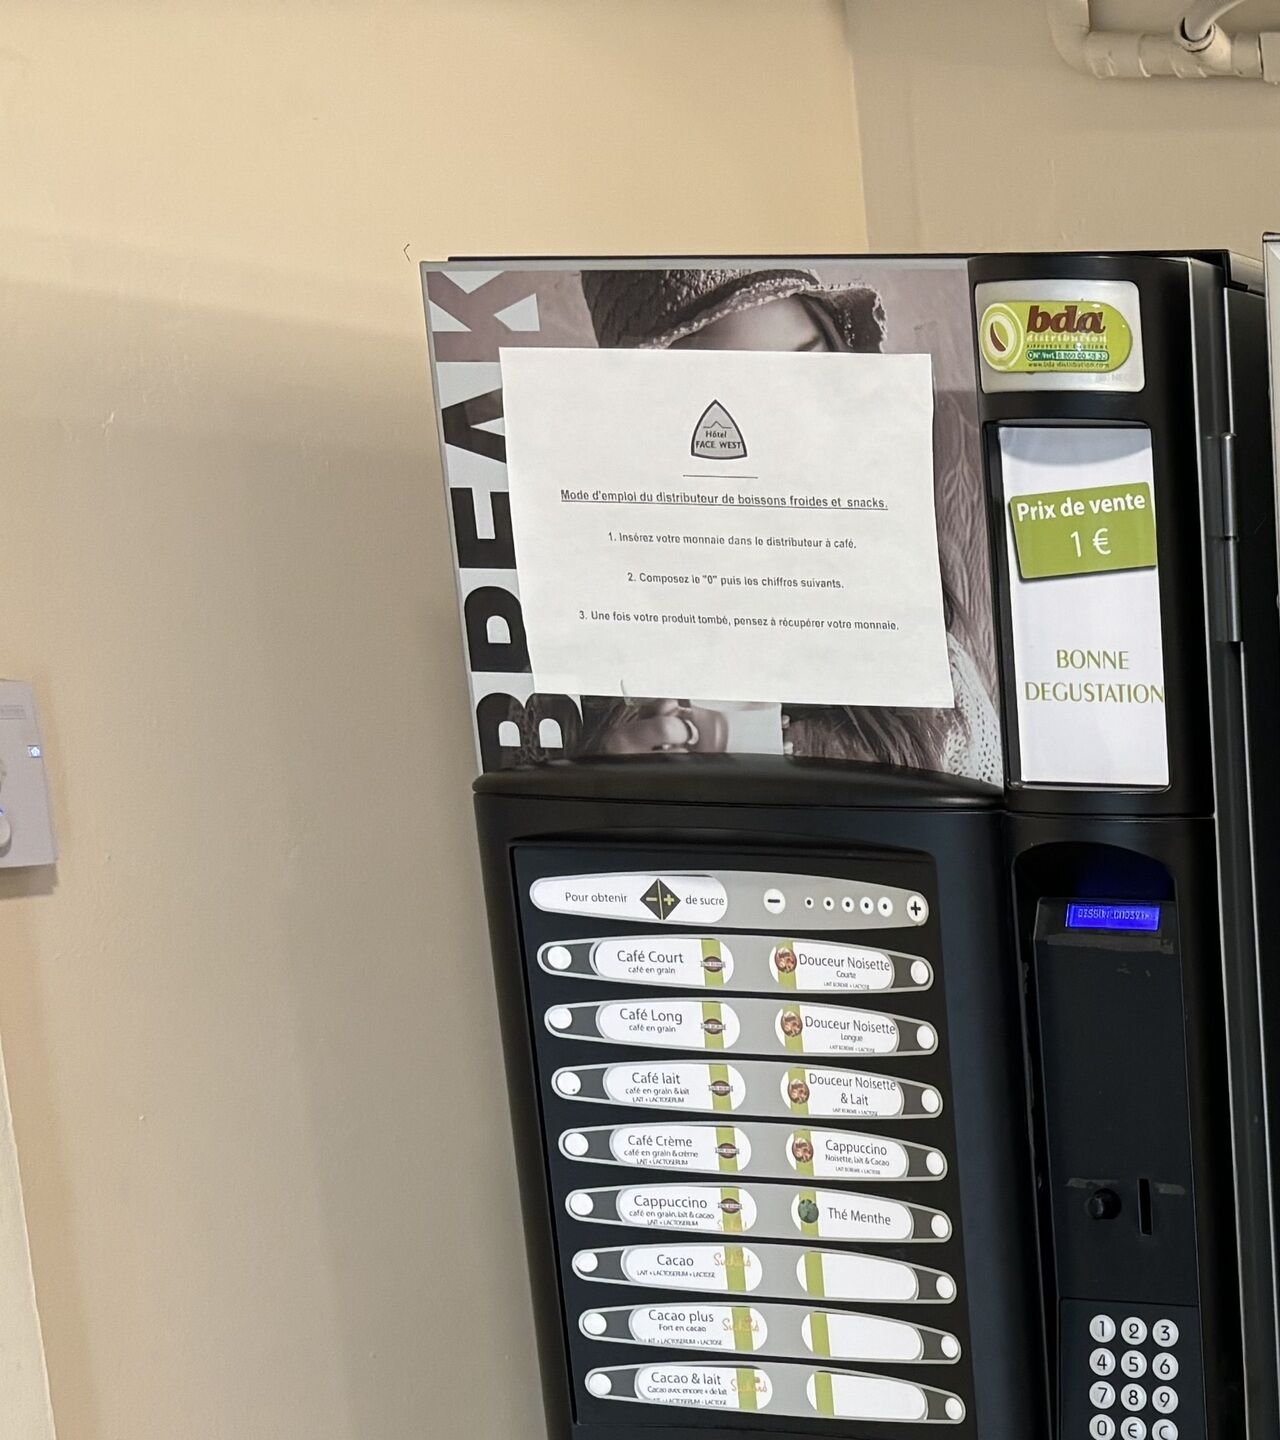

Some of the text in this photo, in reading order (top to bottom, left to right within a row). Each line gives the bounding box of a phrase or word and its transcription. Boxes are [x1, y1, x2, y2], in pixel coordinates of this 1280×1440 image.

[1026, 304, 1106, 334] bda
[1026, 332, 1108, 342] distribution
[706, 430, 727, 438] Hôtel
[695, 441, 742, 449] FACE WEST
[560, 490, 888, 509] Mode d'emploi du distributeur de boissons froides et snacks.
[1017, 492, 1147, 523] Prix de vente
[608, 532, 857, 549] 1. Insérez votre monnaie dans le distributeur à café.
[1070, 528, 1112, 558] 1 €
[627, 572, 845, 590] 2. Composez le "0" puis les chiffres suivants.
[1056, 649, 1130, 671] BONNE
[1024, 682, 1166, 704] DEGUSTATION
[564, 892, 724, 906] Pour obtenir de sucre
[616, 950, 684, 964] Café Court
[799, 954, 890, 972] Douceur Noisette
[620, 1008, 683, 1026] Café Long
[804, 1016, 896, 1034] Douceur Noisette
[632, 1072, 681, 1085] Café lait
[808, 1073, 896, 1092] Douceur Noisette
[840, 1094, 869, 1106] & Lait
[628, 1134, 693, 1148] Café Crème
[826, 1140, 888, 1156] Cappuccino
[634, 1194, 708, 1210] Cappuccino
[827, 1206, 892, 1226] Thé Menthe
[656, 1254, 694, 1267] Cacao
[648, 1310, 714, 1326] Cacao plus
[1099, 1320, 1170, 1341] 1 2 3
[1096, 1354, 1170, 1375] 4 5 6
[651, 1372, 722, 1386] Cacao & lait
[1098, 1386, 1170, 1408] 7 8 9
[1096, 1420, 1169, 1440] 0 C
